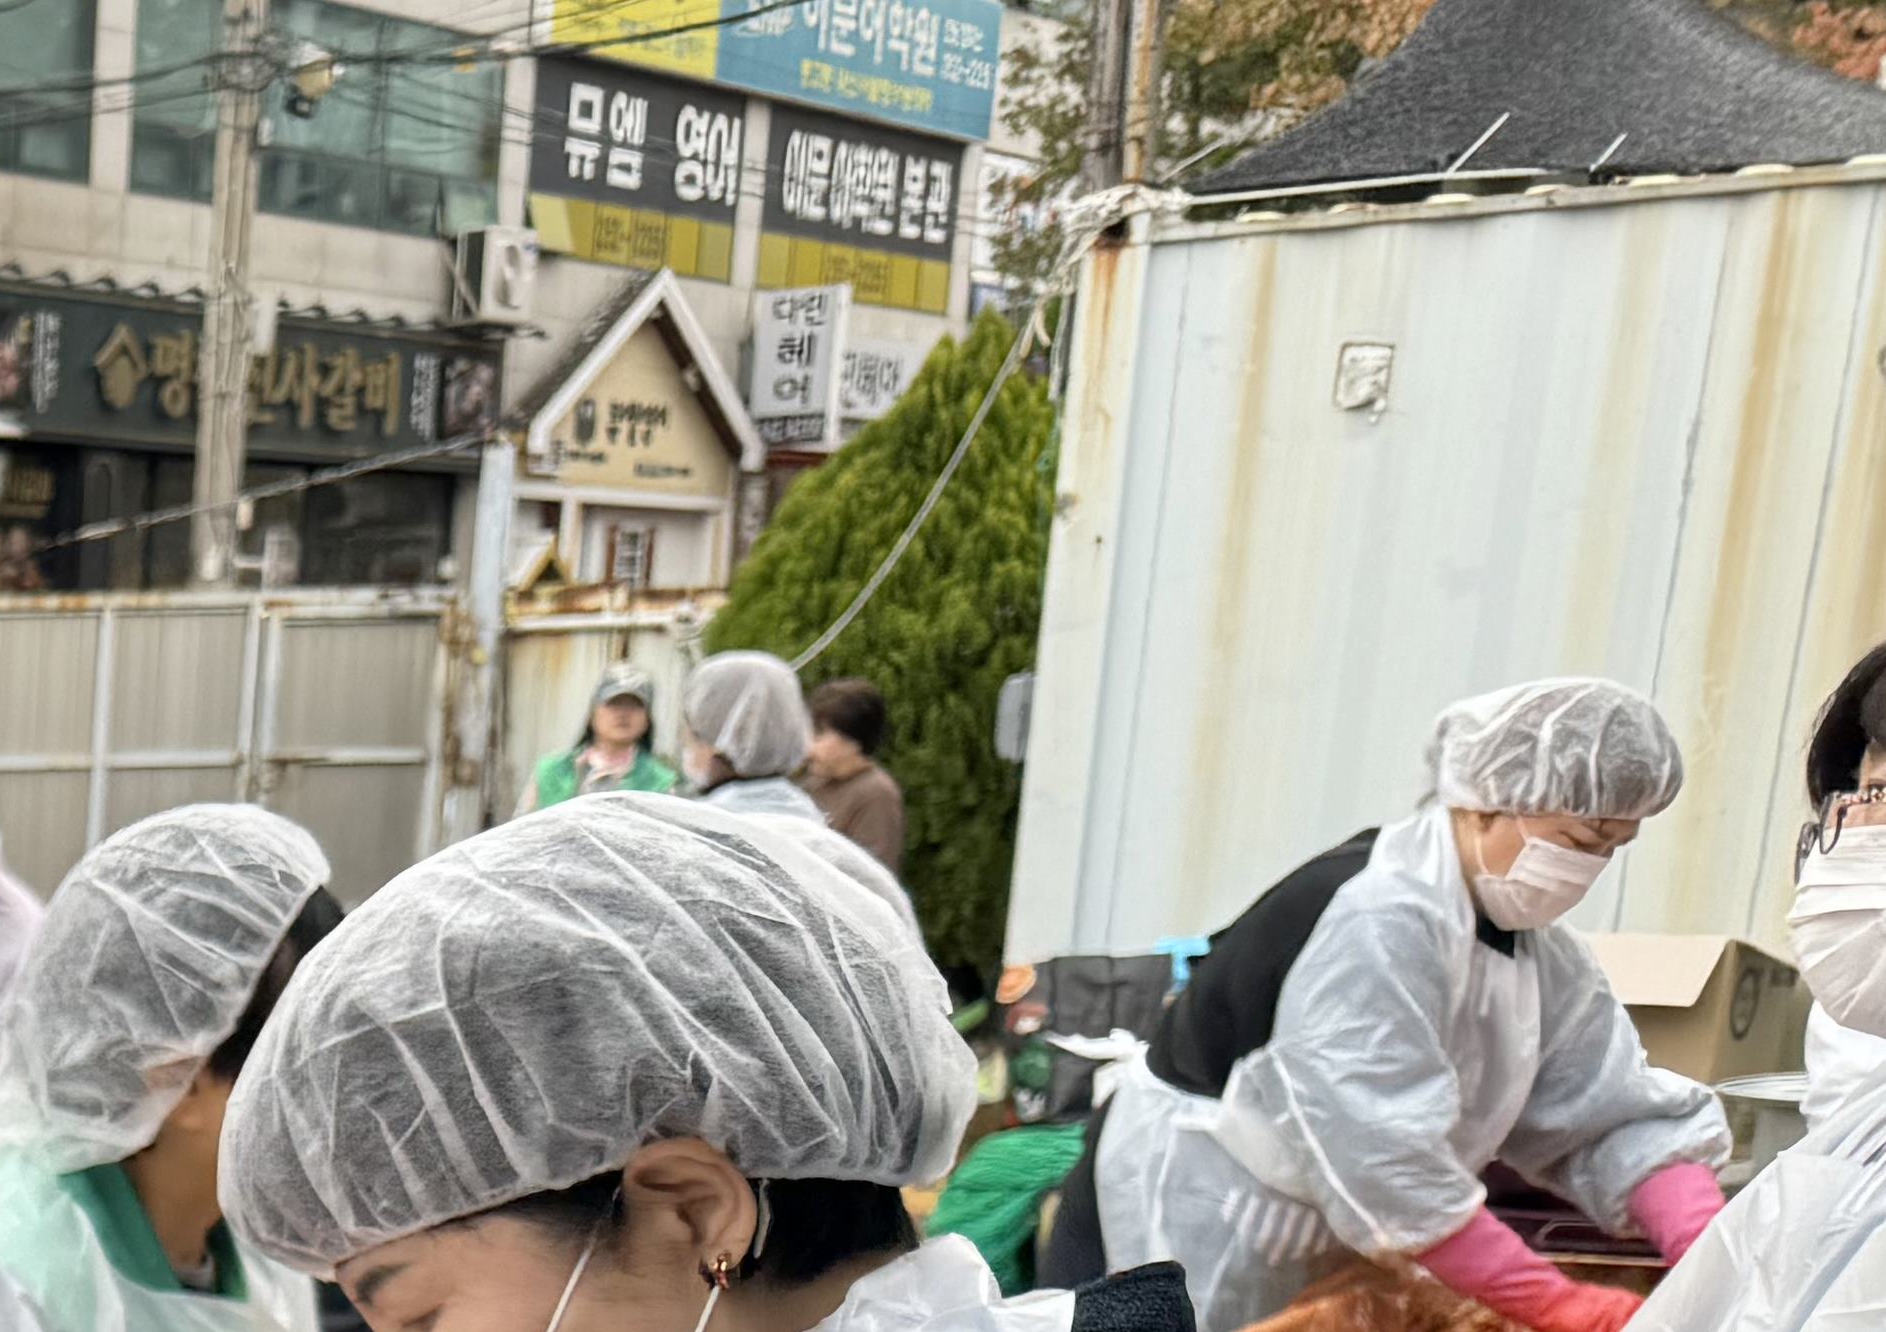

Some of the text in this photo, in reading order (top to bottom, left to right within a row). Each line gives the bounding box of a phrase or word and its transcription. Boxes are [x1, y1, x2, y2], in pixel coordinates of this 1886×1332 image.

[803, 0, 940, 78] 이문어학원
[564, 81, 741, 207] 뮤엠 영어
